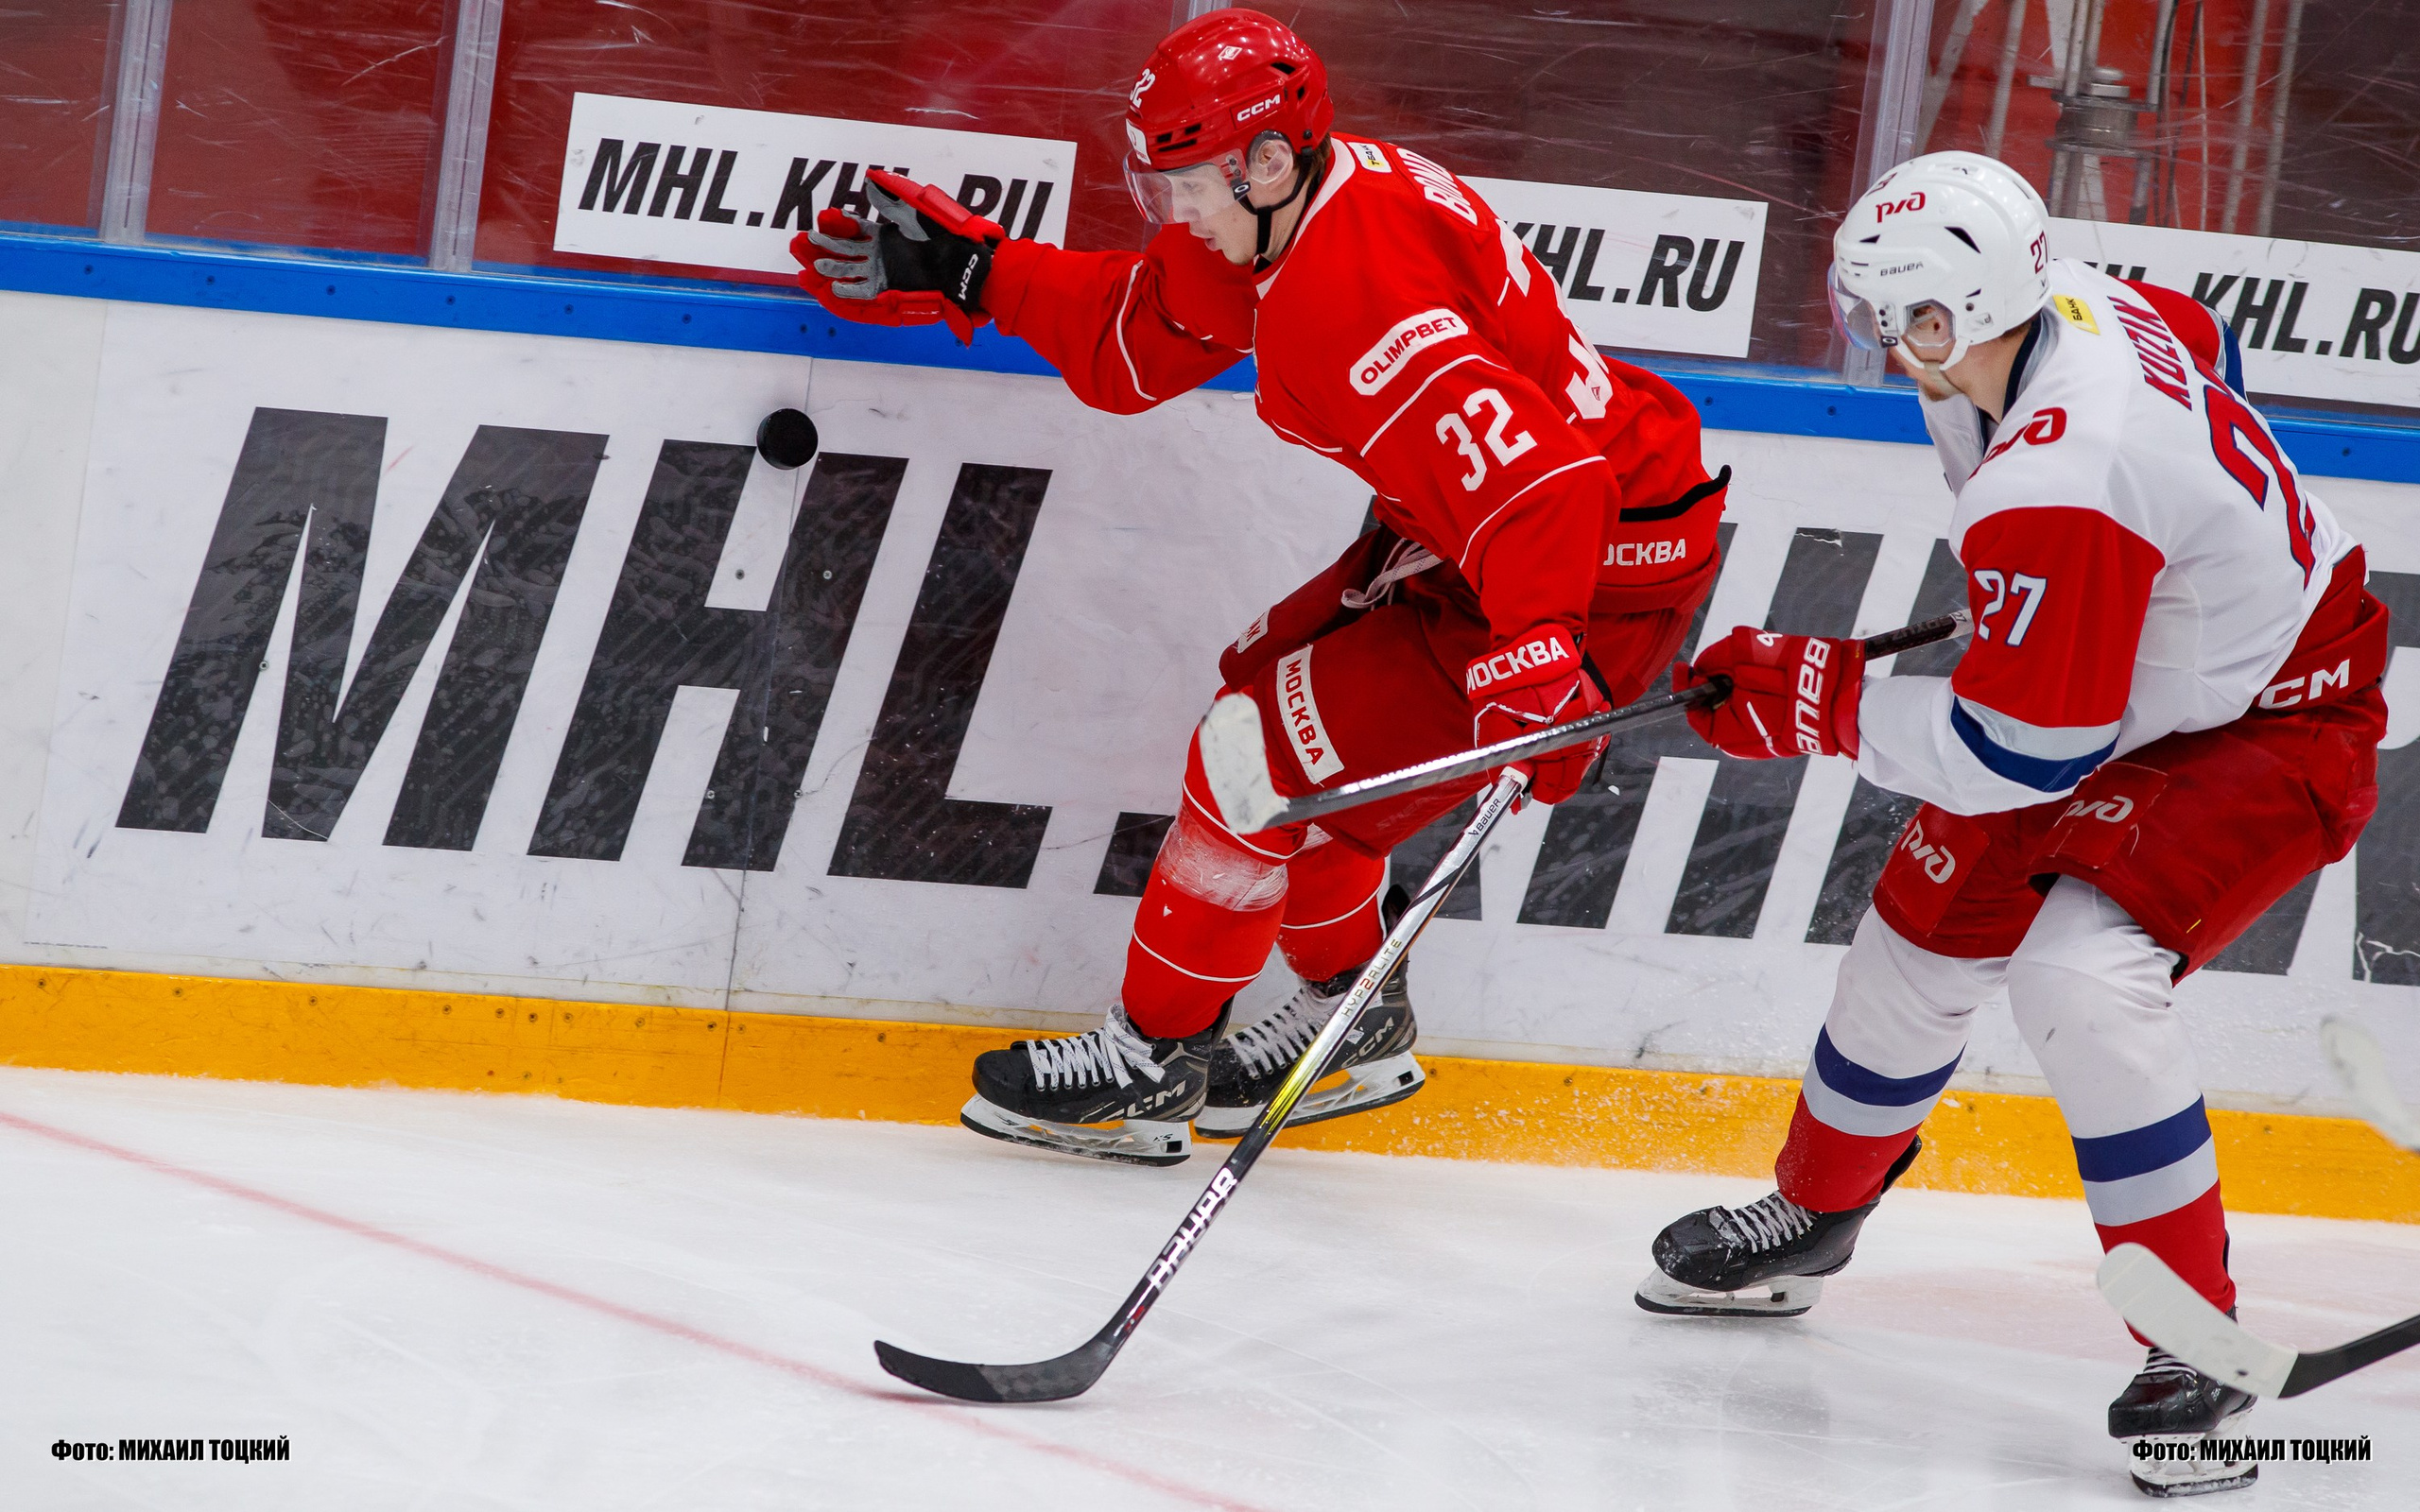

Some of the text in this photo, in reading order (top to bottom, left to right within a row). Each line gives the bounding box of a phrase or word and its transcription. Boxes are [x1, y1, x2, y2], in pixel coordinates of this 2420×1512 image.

[1236, 94, 1281, 123] CCM
[959, 252, 978, 301] CCM
[2030, 230, 2048, 274] 27
[1360, 317, 1458, 385] OLIMPBET
[2107, 295, 2193, 412] KUZIN
[1435, 387, 1538, 491] 32
[1973, 568, 2048, 648] 27
[1285, 658, 1325, 766] МОСКВА
